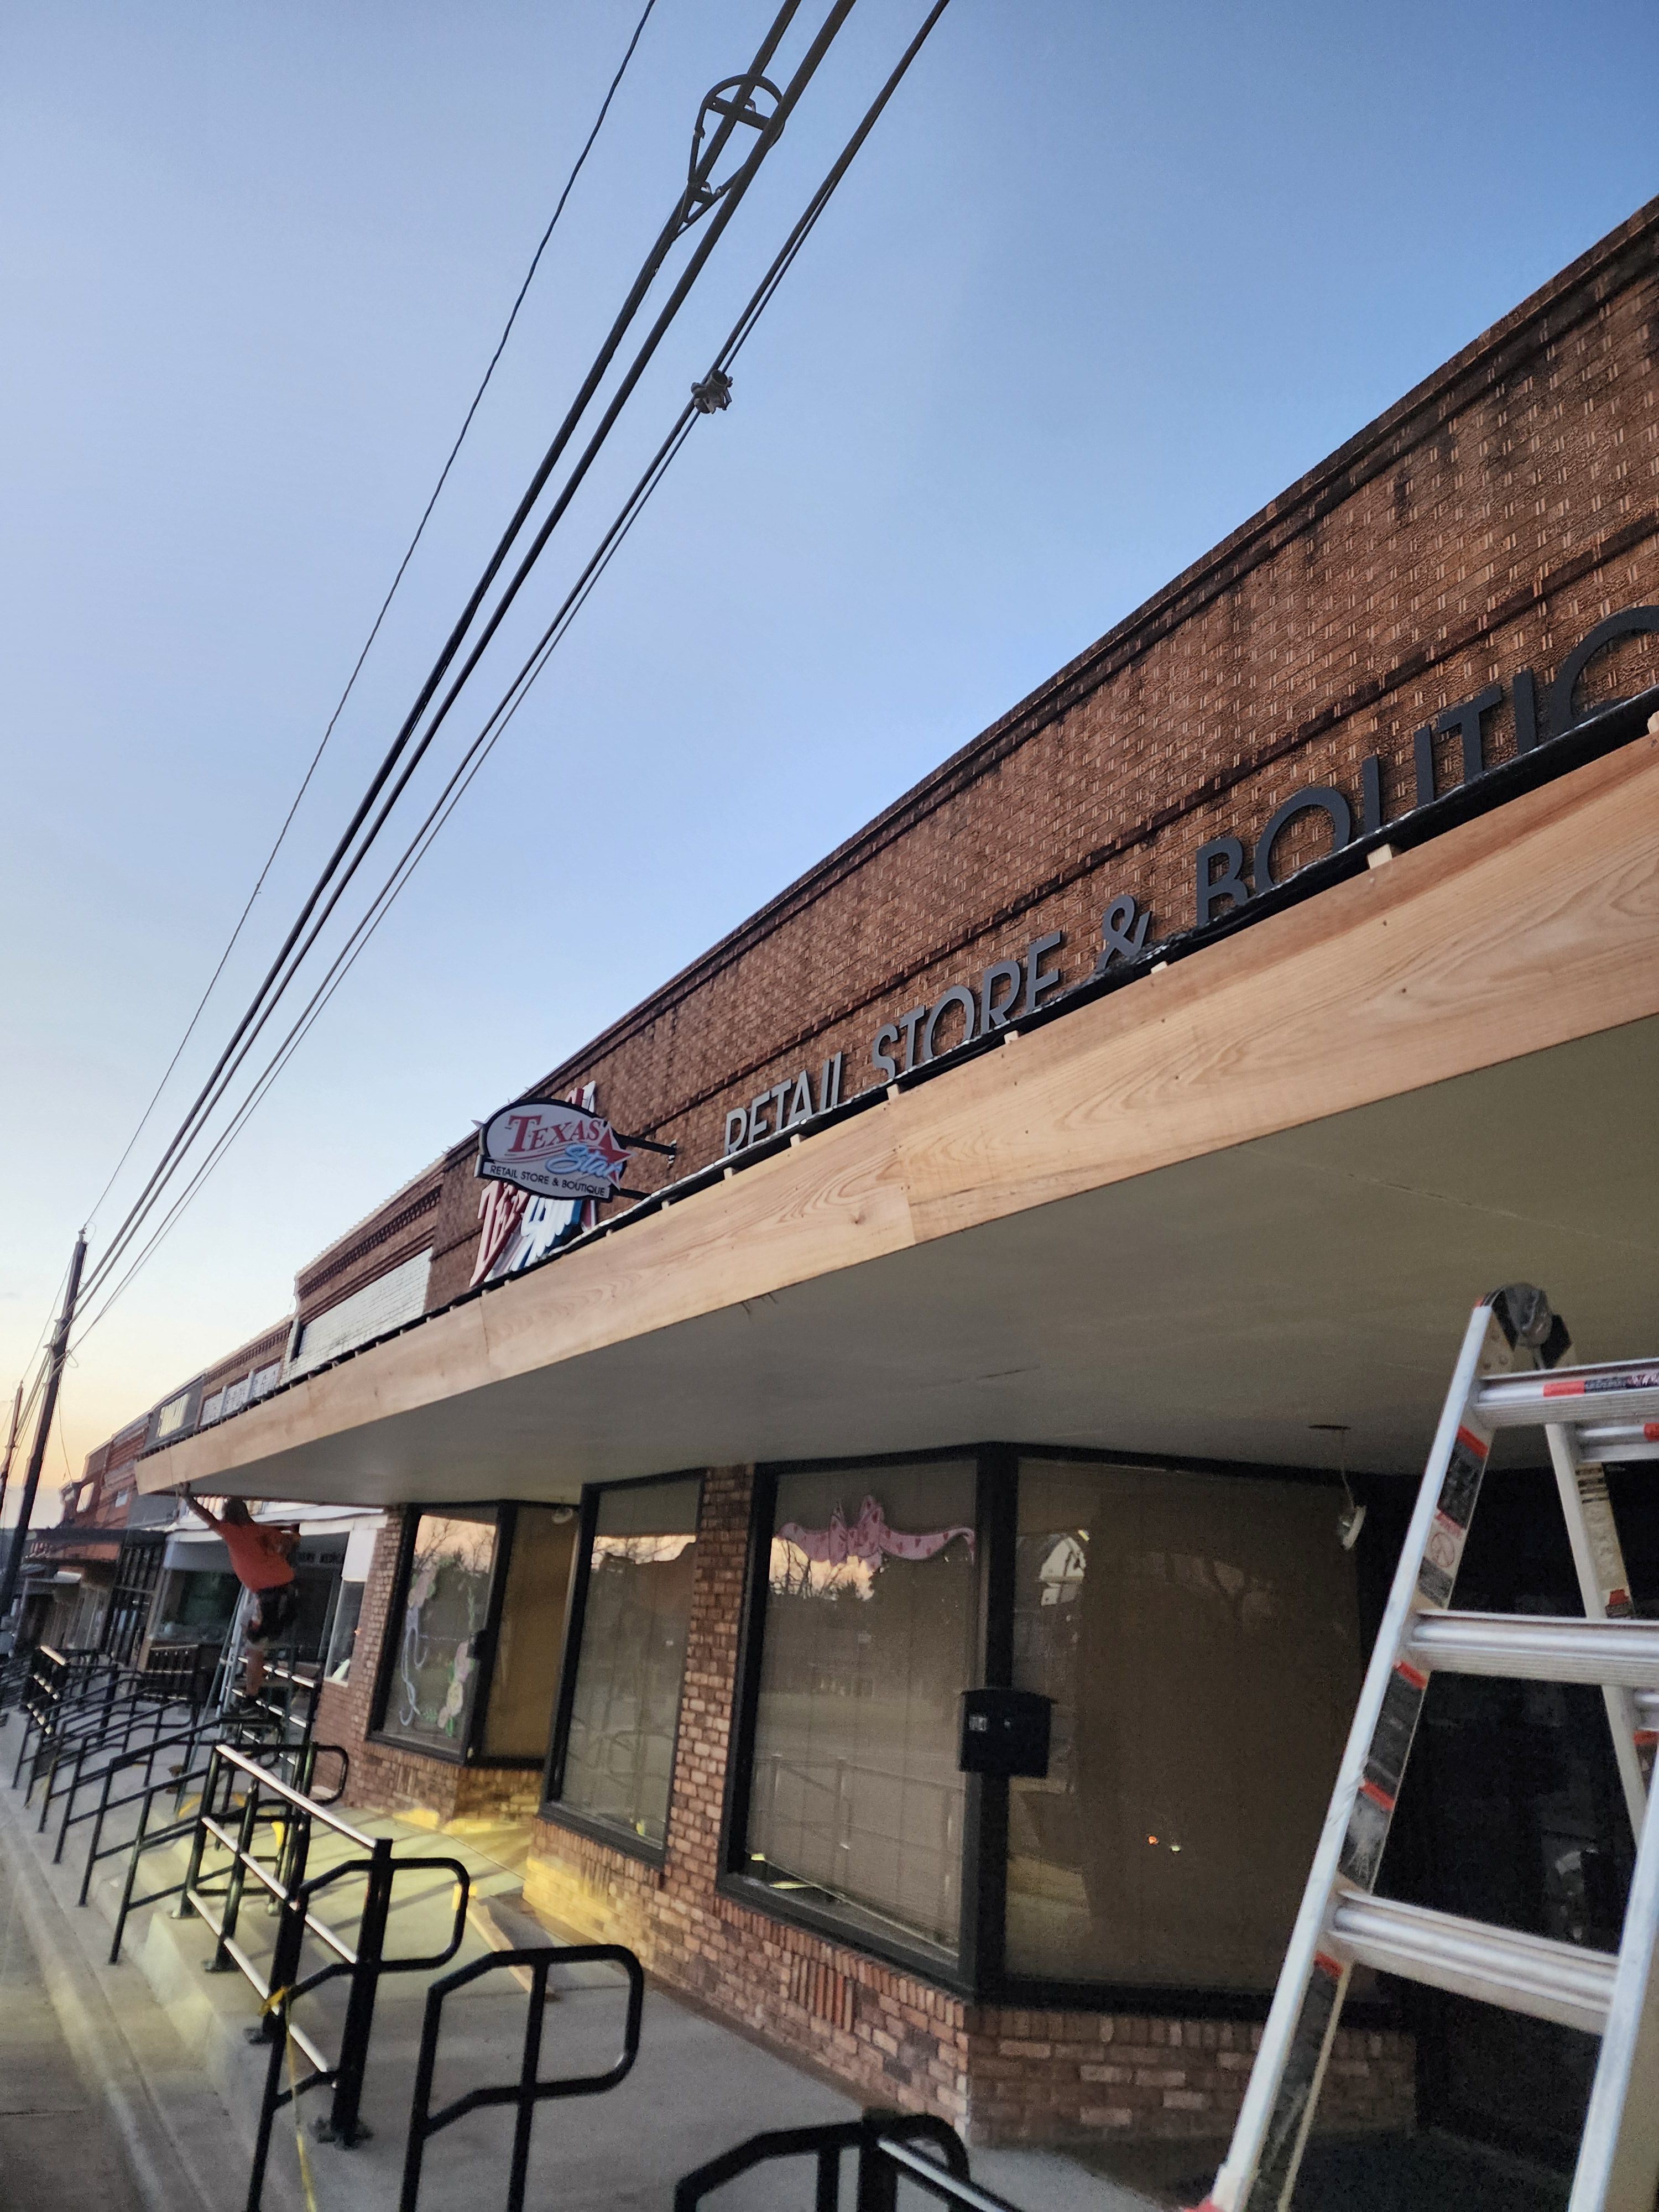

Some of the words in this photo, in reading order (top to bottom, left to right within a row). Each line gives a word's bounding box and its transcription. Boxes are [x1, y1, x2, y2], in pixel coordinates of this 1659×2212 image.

[872, 930, 1061, 1079] STORE
[1092, 894, 1151, 978] &
[545, 1144, 623, 1177] Star
[490, 1165, 518, 1179] RETAIL
[520, 1171, 550, 1185] STORE
[552, 1177, 559, 1186] &
[561, 1179, 605, 1196] BOUTIQUE
